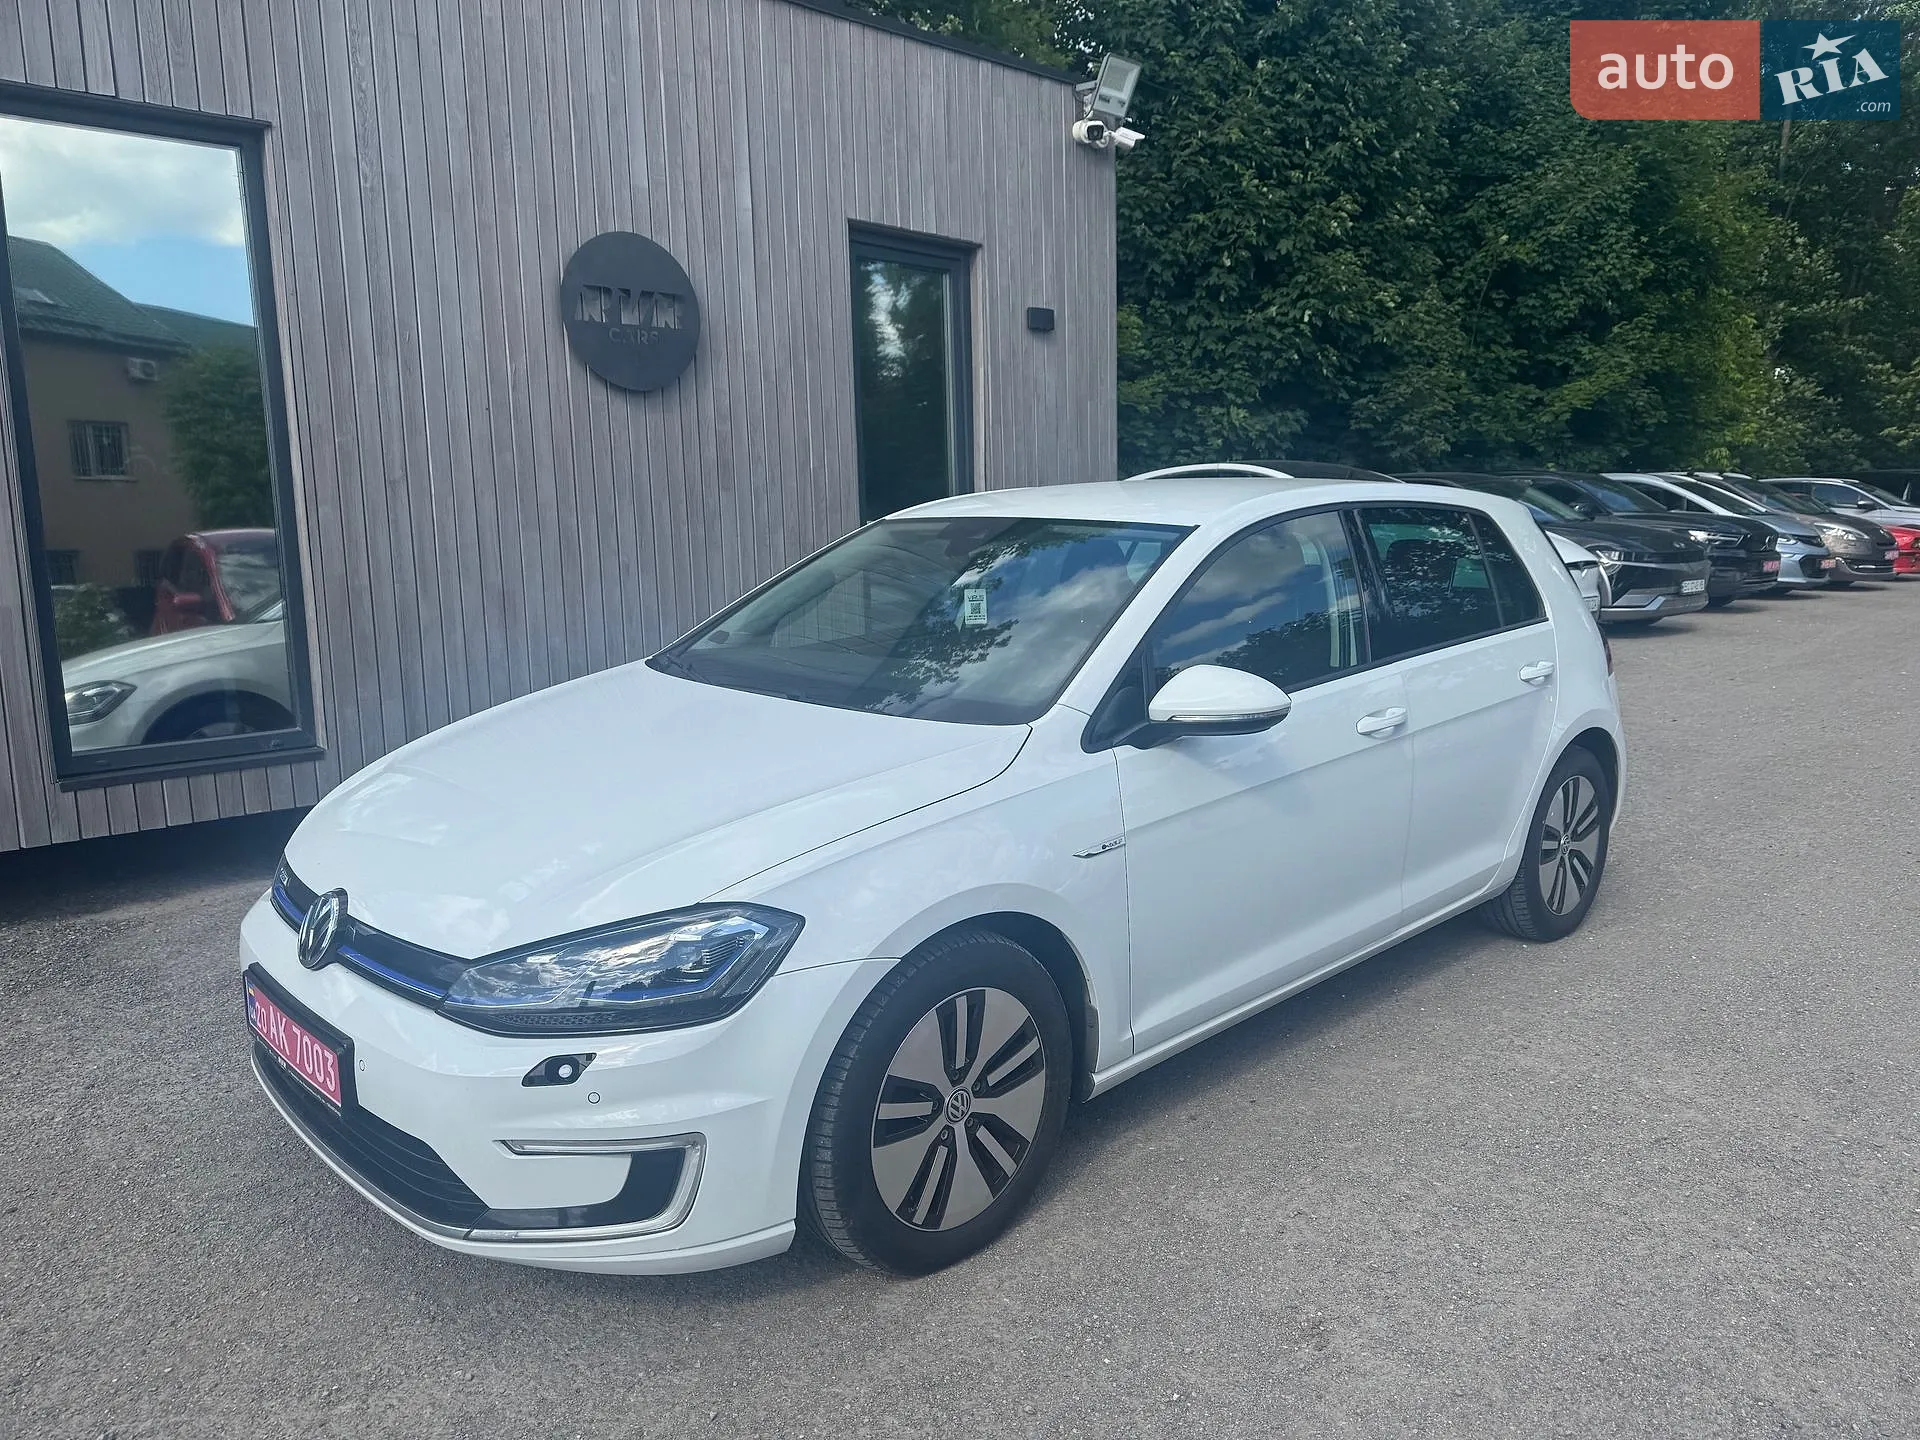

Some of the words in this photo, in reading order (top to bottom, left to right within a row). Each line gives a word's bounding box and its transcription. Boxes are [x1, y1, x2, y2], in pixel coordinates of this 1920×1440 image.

[255, 1001, 268, 1034] 20
[269, 1005, 290, 1056] AK
[292, 1025, 336, 1092] 7003
